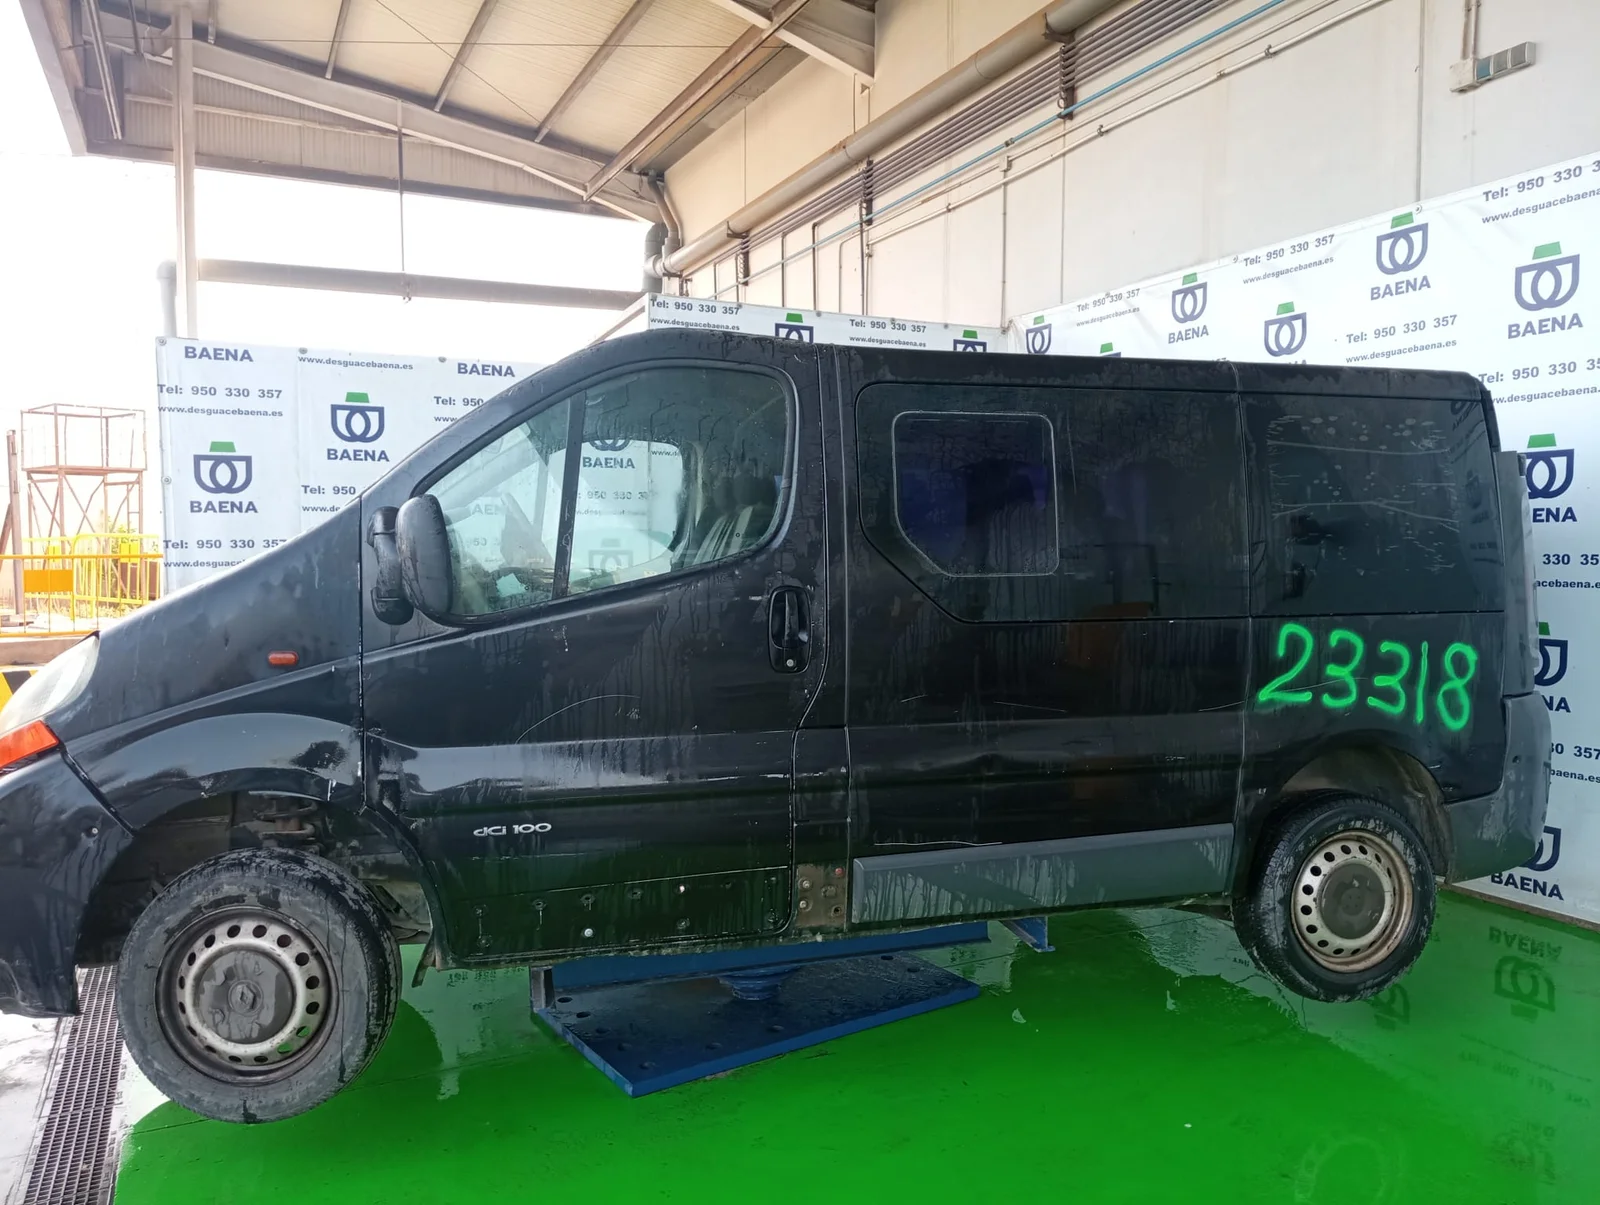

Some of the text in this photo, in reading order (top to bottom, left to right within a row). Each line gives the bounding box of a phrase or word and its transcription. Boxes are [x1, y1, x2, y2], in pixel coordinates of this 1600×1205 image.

[1482, 186, 1509, 202] Tel:
[1516, 176, 1545, 193] 950
[1553, 165, 1582, 183] 330
[1243, 233, 1335, 267] Tel: 950 330 357
[1242, 256, 1335, 284] www.desguacebaena.es
[1370, 275, 1431, 301] BAENA
[1092, 297, 1106, 308] 950
[1109, 293, 1123, 303] 330
[1126, 288, 1140, 299] 357
[650, 299, 740, 315] Tel: 950 330 357
[650, 317, 740, 331] www.desguacebaena.es
[849, 319, 927, 333] Tel: 950 330 357
[1346, 314, 1457, 344] Tel: 950 330 357
[1507, 312, 1584, 340] BAENA
[849, 335, 927, 347] www.desguacebaena.es
[1168, 324, 1209, 344] BAENA
[184, 346, 254, 362] BAENA
[1345, 339, 1457, 364] www.desguacebaena.es
[298, 355, 414, 370] www.desguacebaena.es
[457, 362, 516, 378] BAENA
[1478, 371, 1504, 384] Tel:
[1512, 366, 1540, 380] 950
[1548, 361, 1577, 375] 330
[157, 384, 283, 399] Tel: 950 330 357
[433, 396, 484, 407] Tel: 950
[158, 405, 284, 417] www.desguacebaena.es
[327, 448, 390, 462] BAENA
[582, 456, 636, 469] BAENA
[301, 485, 356, 495] Tel: 950
[190, 500, 258, 513] BAENA
[163, 539, 188, 549] Tel:
[196, 539, 222, 549] 950
[230, 539, 255, 549] 330
[1542, 553, 1571, 565] 330
[1257, 622, 1479, 731] 23318
[1573, 745, 1600, 760] 357
[512, 822, 552, 834] 100
[1490, 871, 1565, 901] BAENA
